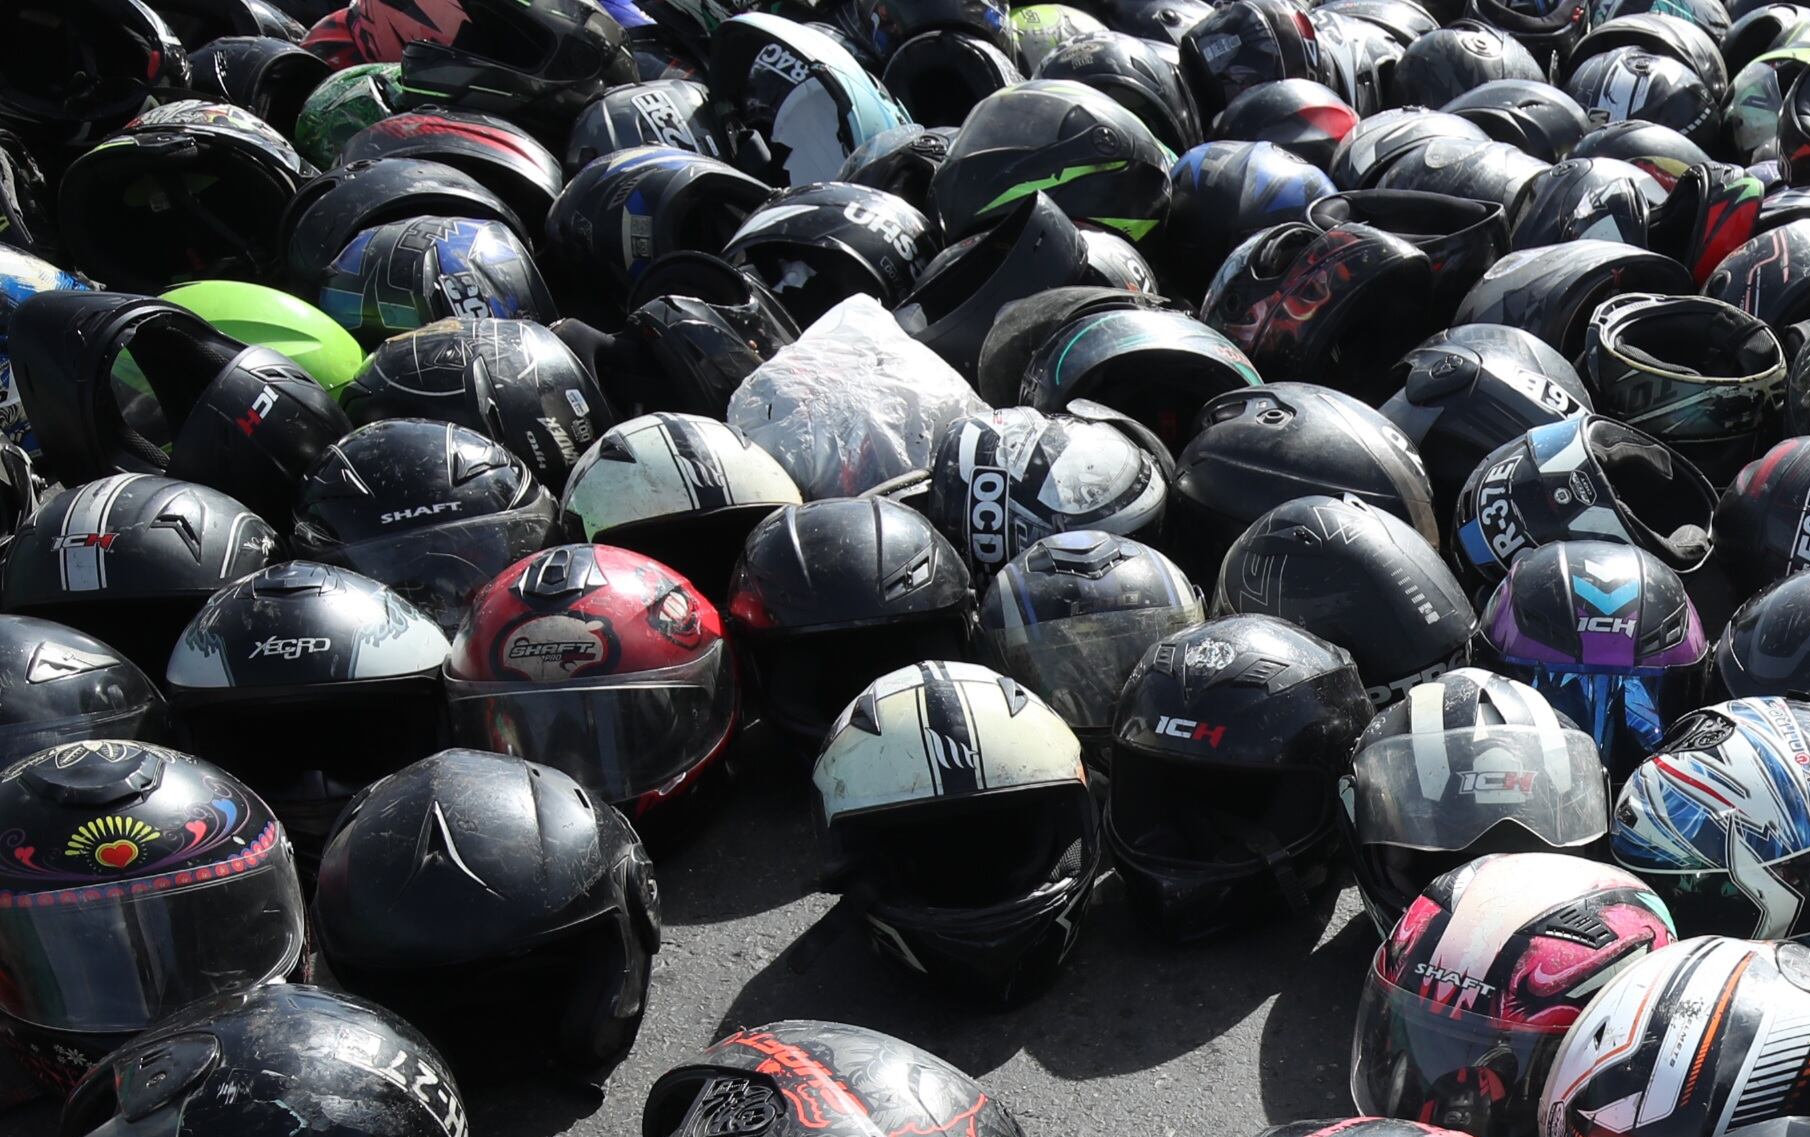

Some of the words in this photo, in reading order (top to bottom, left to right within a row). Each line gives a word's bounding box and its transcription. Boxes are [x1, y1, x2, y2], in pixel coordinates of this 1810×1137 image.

[235, 383, 283, 438] ICH
[381, 502, 462, 525] SHAFT
[1576, 616, 1639, 640] ICH
[510, 641, 596, 658] SHAFT
[1154, 715, 1227, 749] ICH
[1458, 771, 1539, 796] ICH
[1415, 962, 1498, 999] SHAFT
